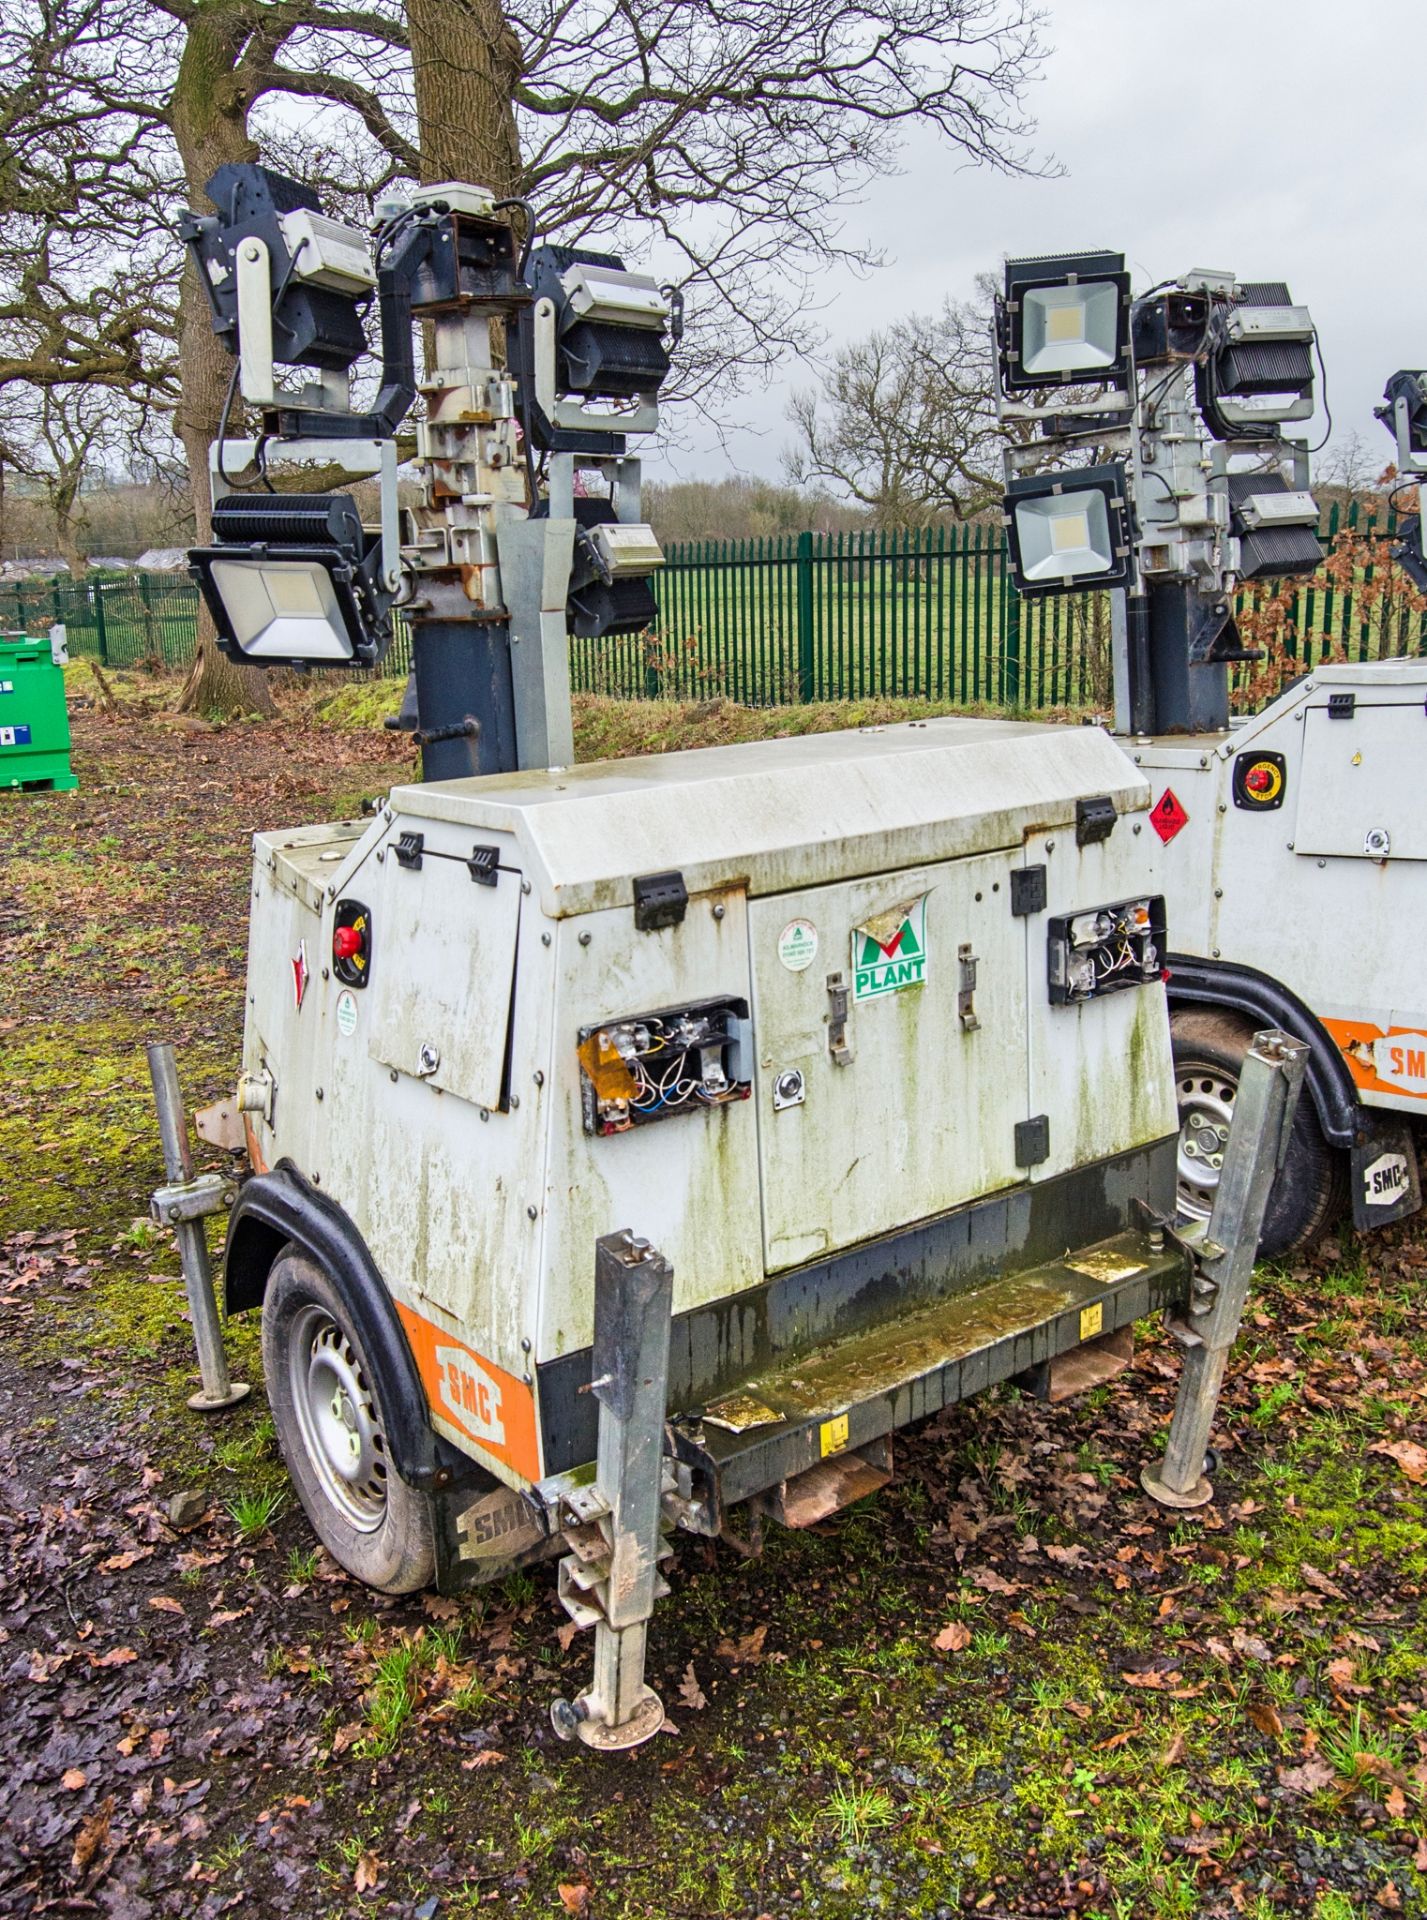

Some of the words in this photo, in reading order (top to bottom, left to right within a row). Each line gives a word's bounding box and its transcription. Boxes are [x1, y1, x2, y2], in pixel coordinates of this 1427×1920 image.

[856, 958, 926, 994] PLANT
[1373, 1165, 1401, 1195] SMC
[447, 1361, 491, 1426] SMC
